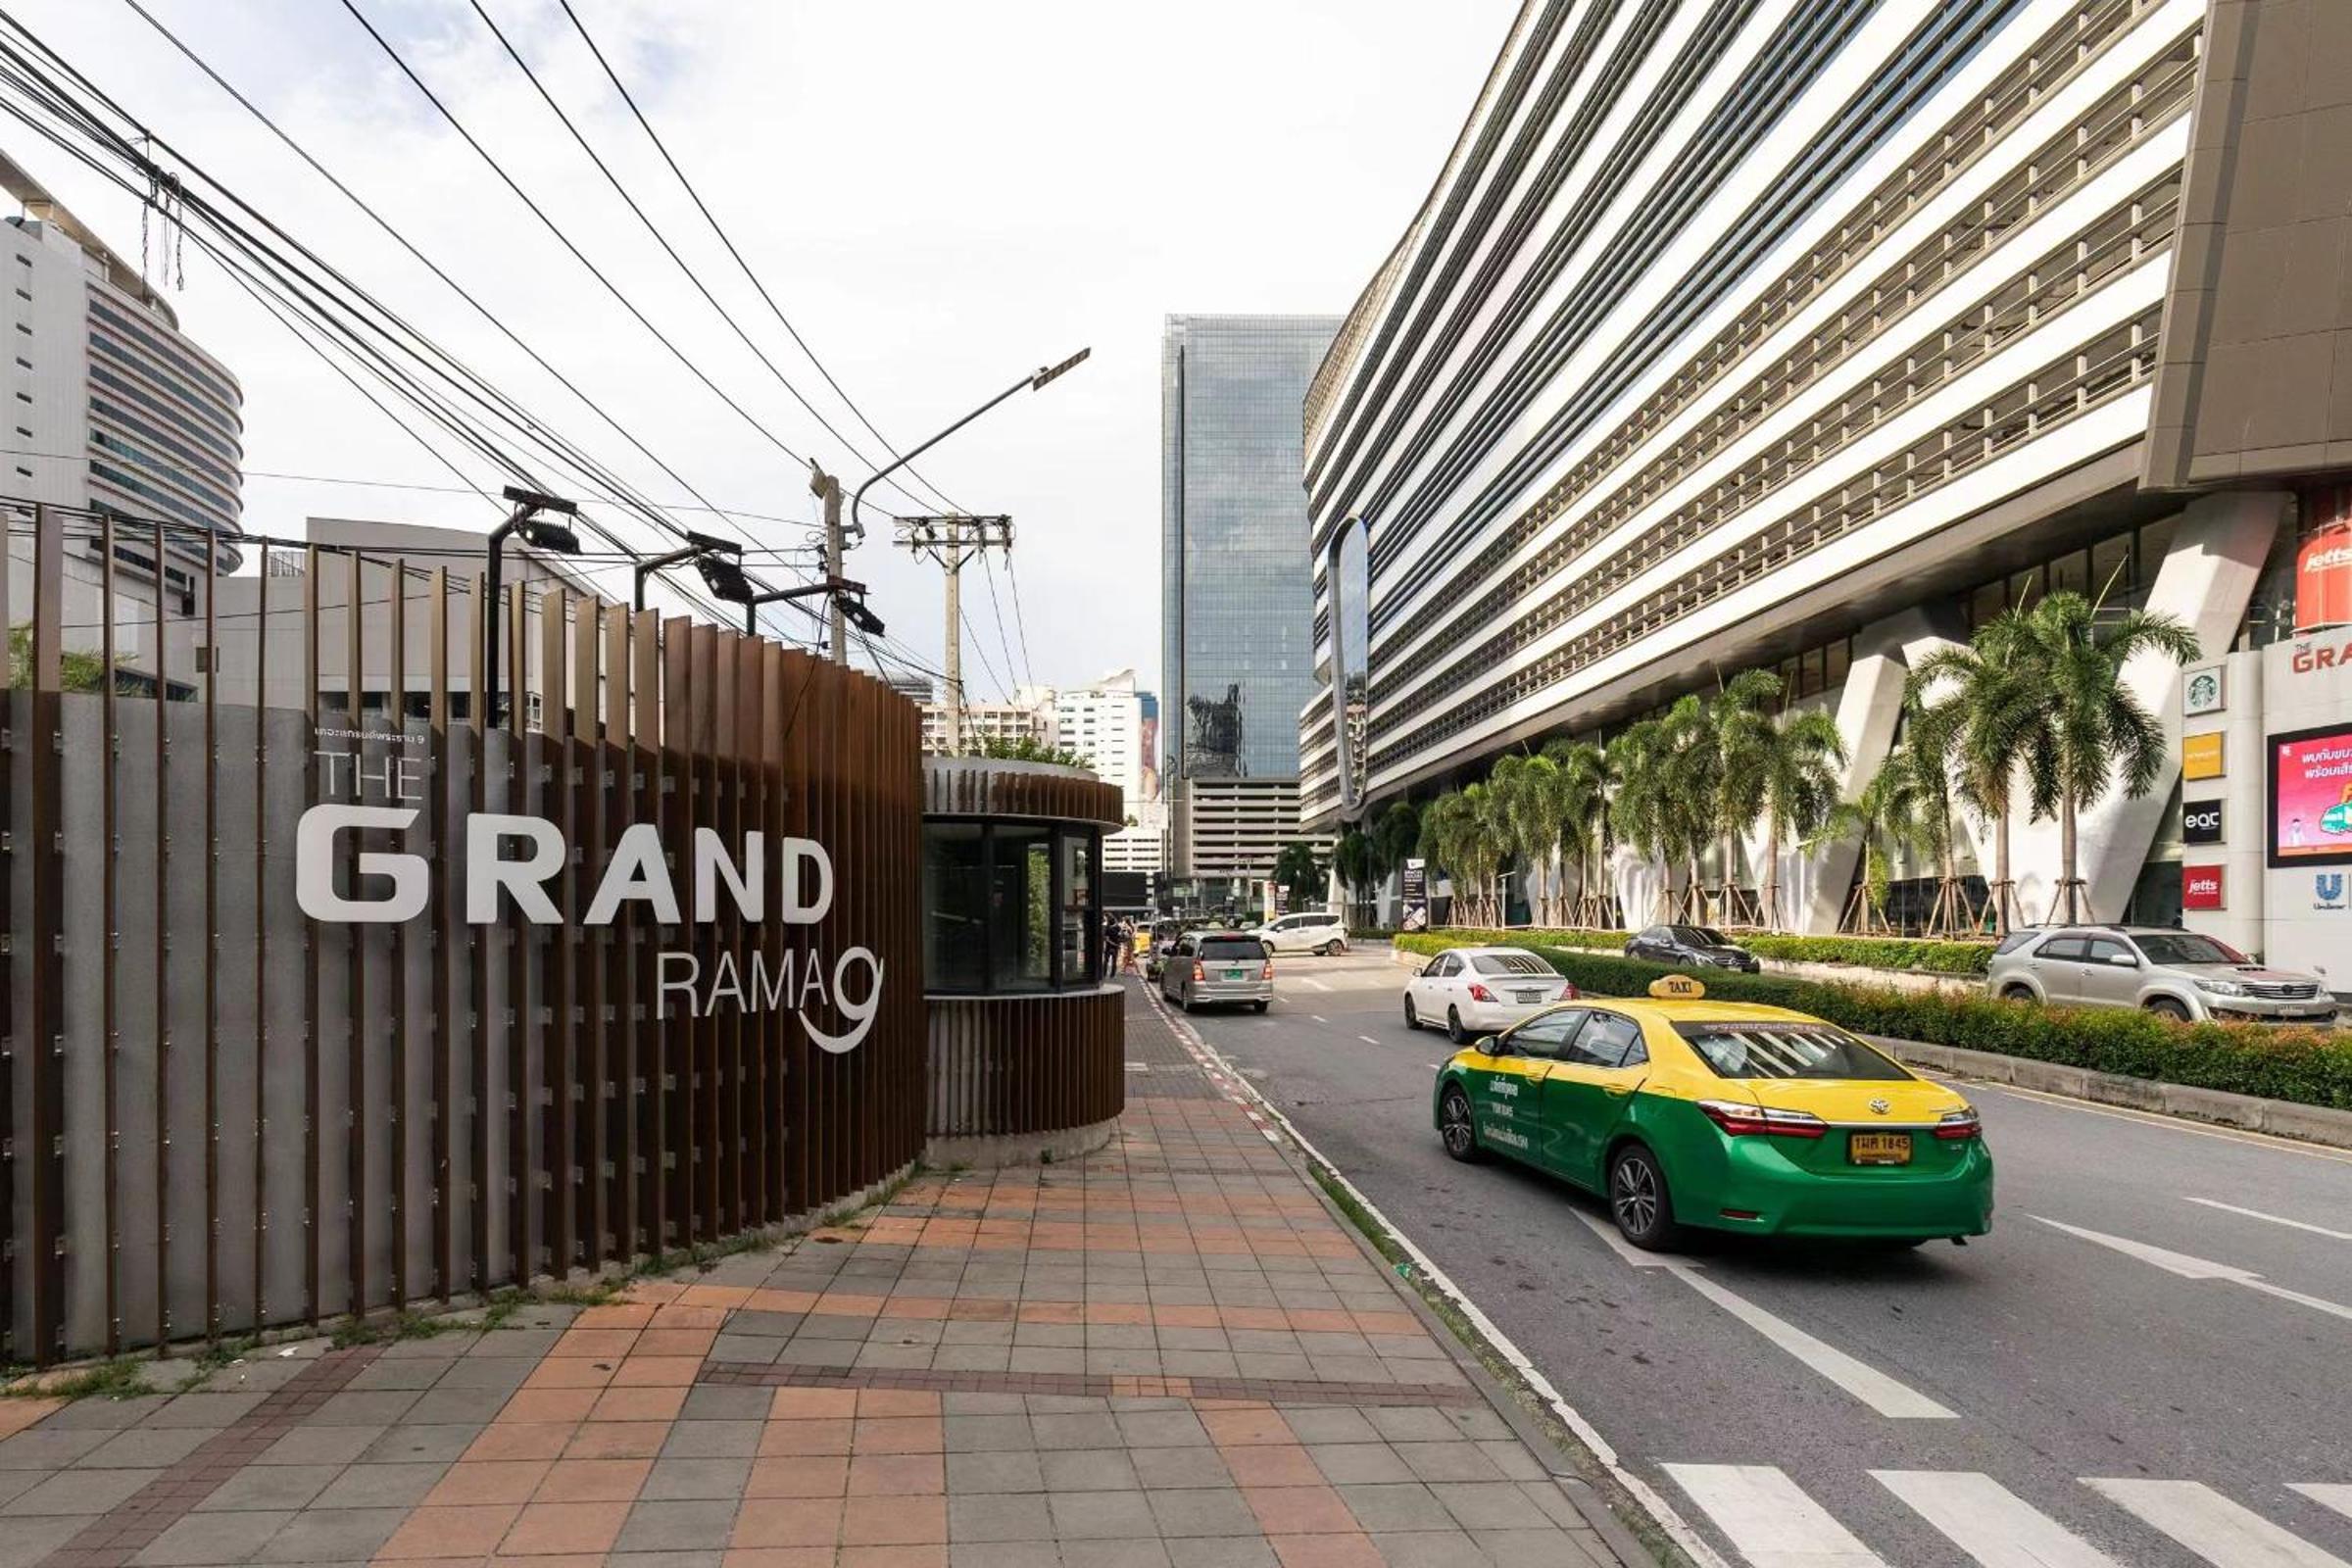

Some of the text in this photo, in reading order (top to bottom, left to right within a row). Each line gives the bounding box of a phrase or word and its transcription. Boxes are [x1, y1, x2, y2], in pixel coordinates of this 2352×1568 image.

[314, 751, 422, 800] THE
[296, 803, 834, 924] GRAND
[1668, 981, 1692, 994] TAXI
